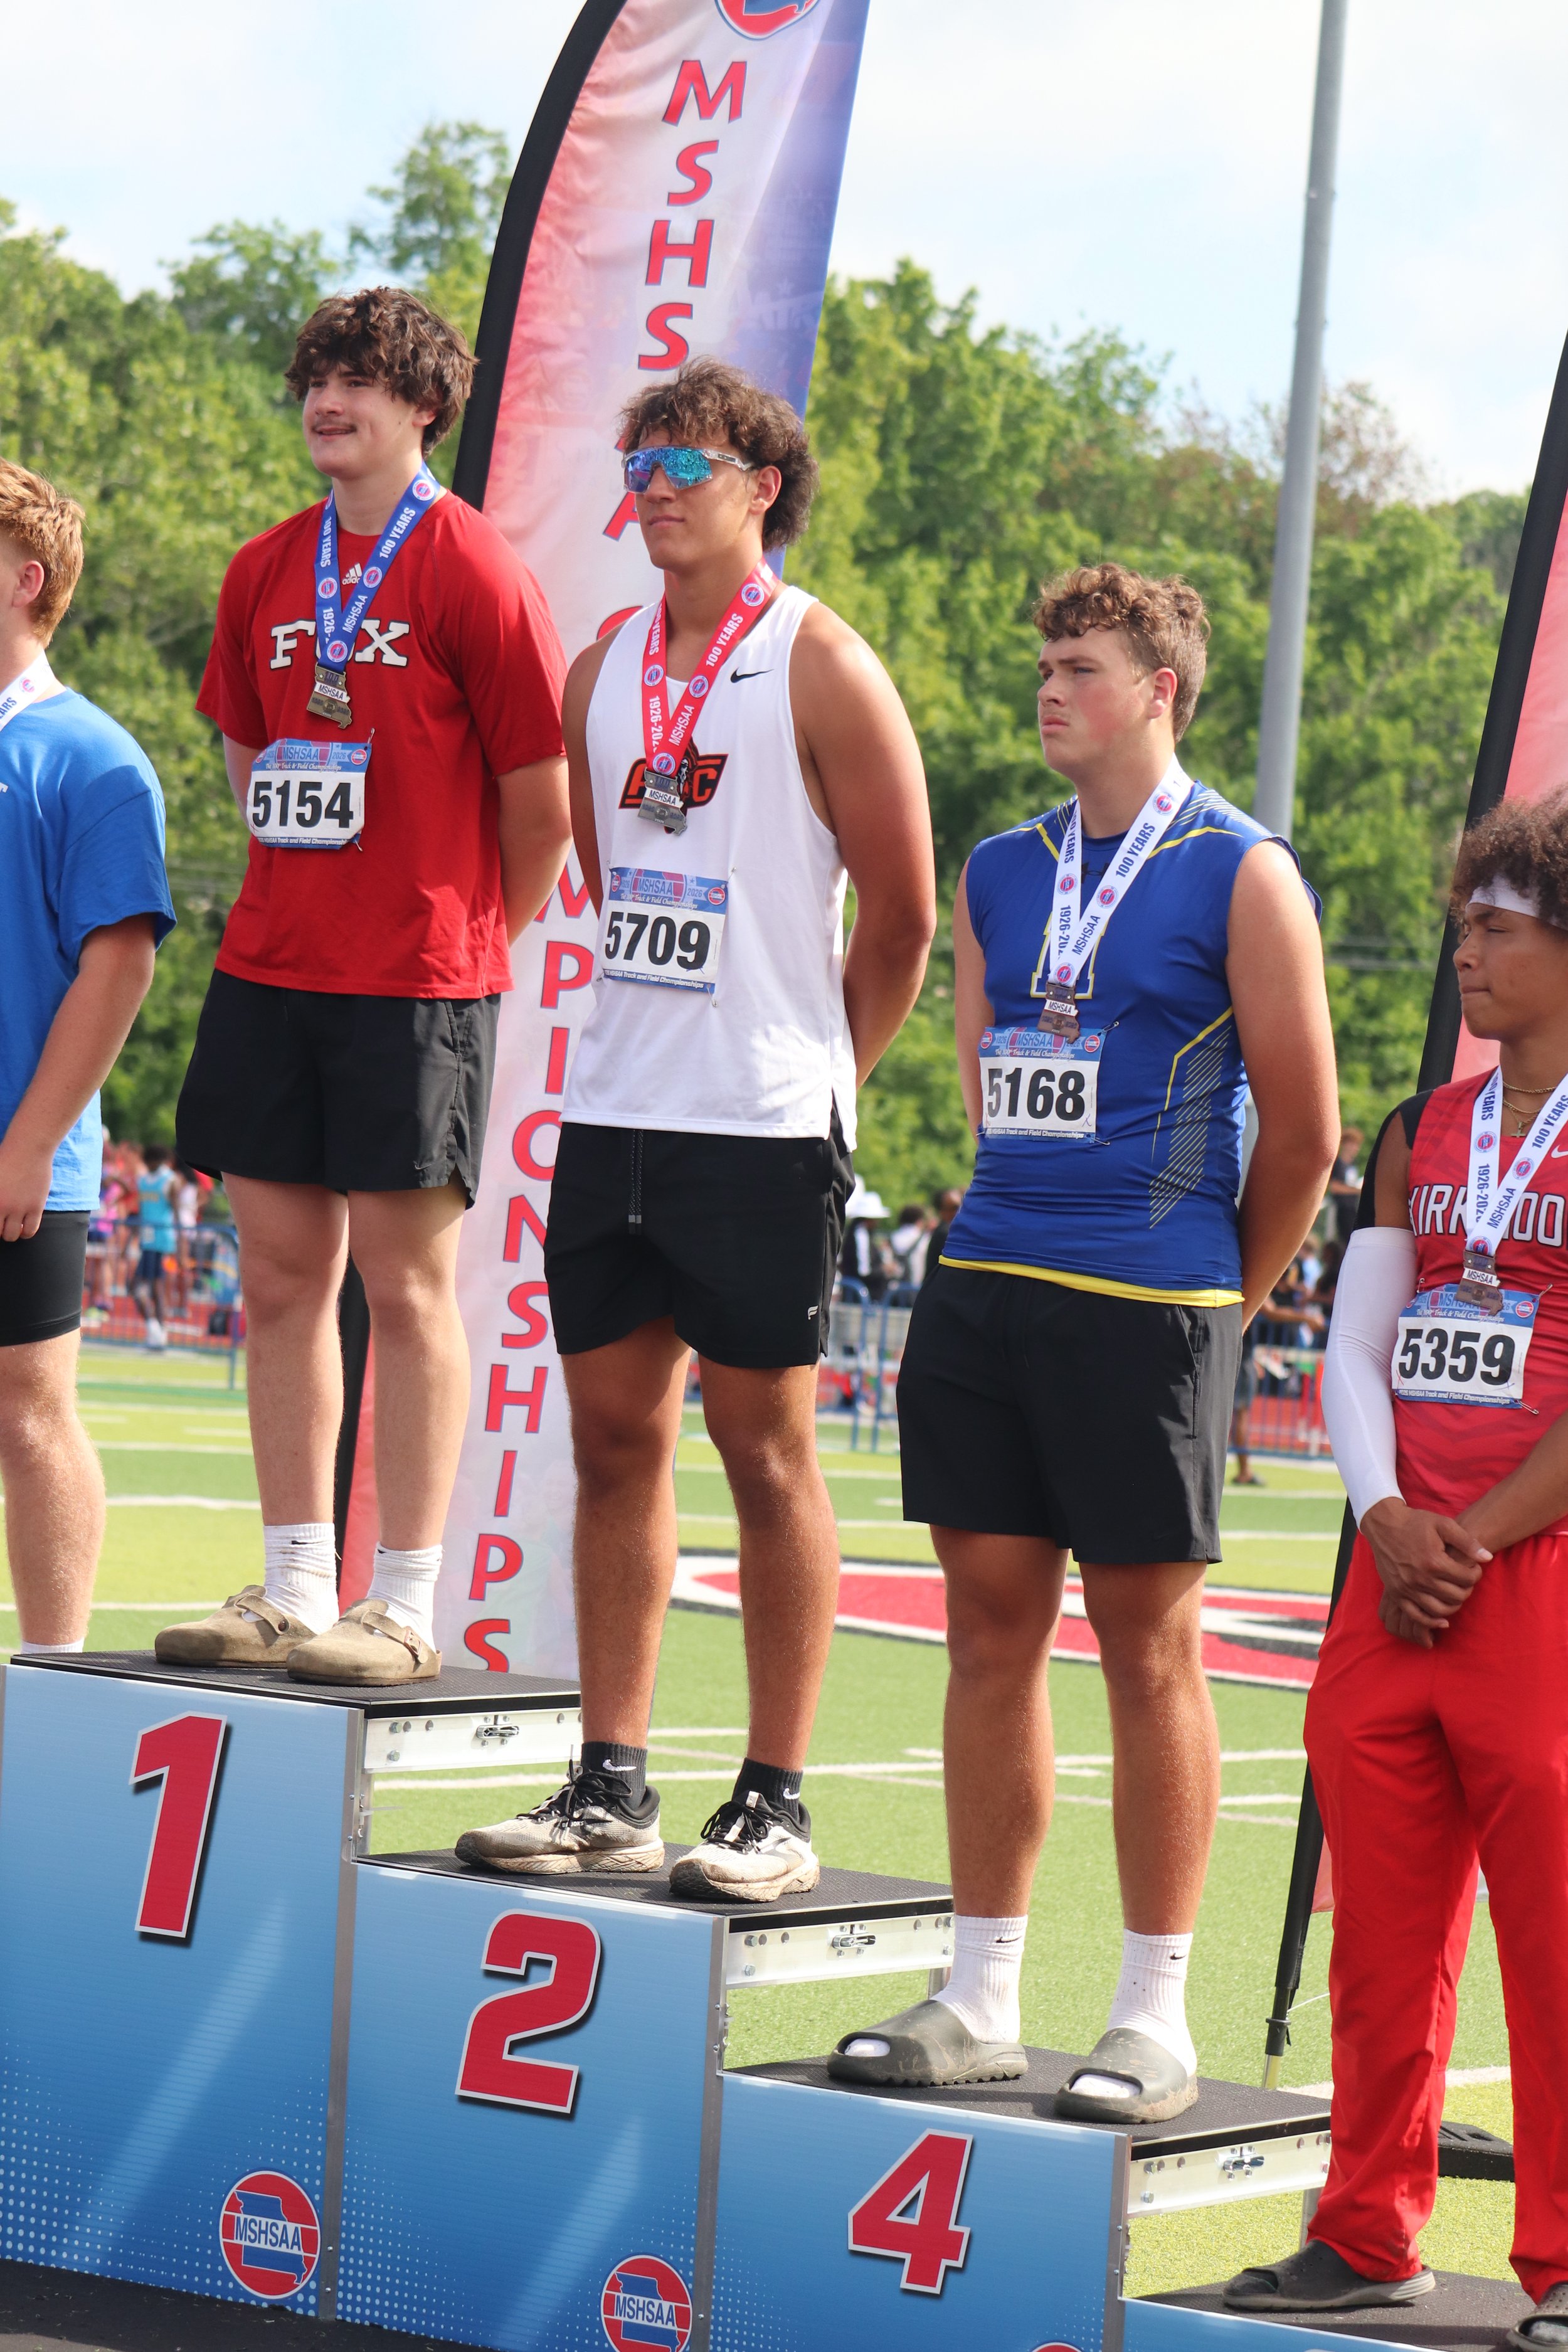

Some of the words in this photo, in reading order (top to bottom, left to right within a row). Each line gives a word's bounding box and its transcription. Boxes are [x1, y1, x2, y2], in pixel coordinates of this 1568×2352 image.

[323, 516, 332, 536] 100
[379, 539, 396, 559] 100
[389, 507, 416, 540] YEARS
[320, 537, 332, 568] YEARS
[322, 607, 335, 644] 1926-
[342, 595, 368, 633] MSHSAA
[270, 618, 410, 670] FX
[649, 623, 661, 656] YEARS
[706, 646, 723, 667] 100
[716, 613, 744, 647] YEARS
[318, 684, 344, 701] MSHSAA
[649, 695, 664, 753] 1926-202
[668, 704, 695, 746] MSHSAA
[282, 746, 319, 760] MSHSAA
[252, 780, 354, 829] 5154
[649, 790, 677, 806] MSHSAA
[312, 838, 347, 846] Championshi
[1064, 829, 1077, 864] YEARS
[1115, 856, 1135, 878] 100
[1127, 822, 1155, 857] YEARS
[635, 894, 645, 902] Track
[651, 896, 662, 904] Field
[638, 877, 673, 896] MSHSAA
[687, 887, 703, 898] 2026
[605, 911, 711, 970] 5709
[1071, 914, 1101, 955] MSHSAA
[659, 977, 704, 989] Championships
[1048, 1001, 1073, 1014] MSHSAA
[1012, 1048, 1024, 1056] Track
[1016, 1032, 1052, 1047] MSHSAA
[987, 1067, 1085, 1121] 5168
[1481, 1090, 1495, 1121] YEARS
[1042, 1130, 1084, 1140] Championships
[1532, 1128, 1550, 1149] 100
[1486, 1187, 1517, 1229] MSHSAA
[1466, 1270, 1493, 1285] MSHSAA
[1434, 1308, 1448, 1316] Track
[1399, 1328, 1515, 1386] 5359
[1463, 1393, 1510, 1405] Championships
[129, 1710, 228, 1939] 1
[455, 1909, 601, 2114] 2
[848, 2128, 973, 2294] 4
[235, 2215, 302, 2252] MSHSAA
[615, 2294, 675, 2327] MSHSAA
